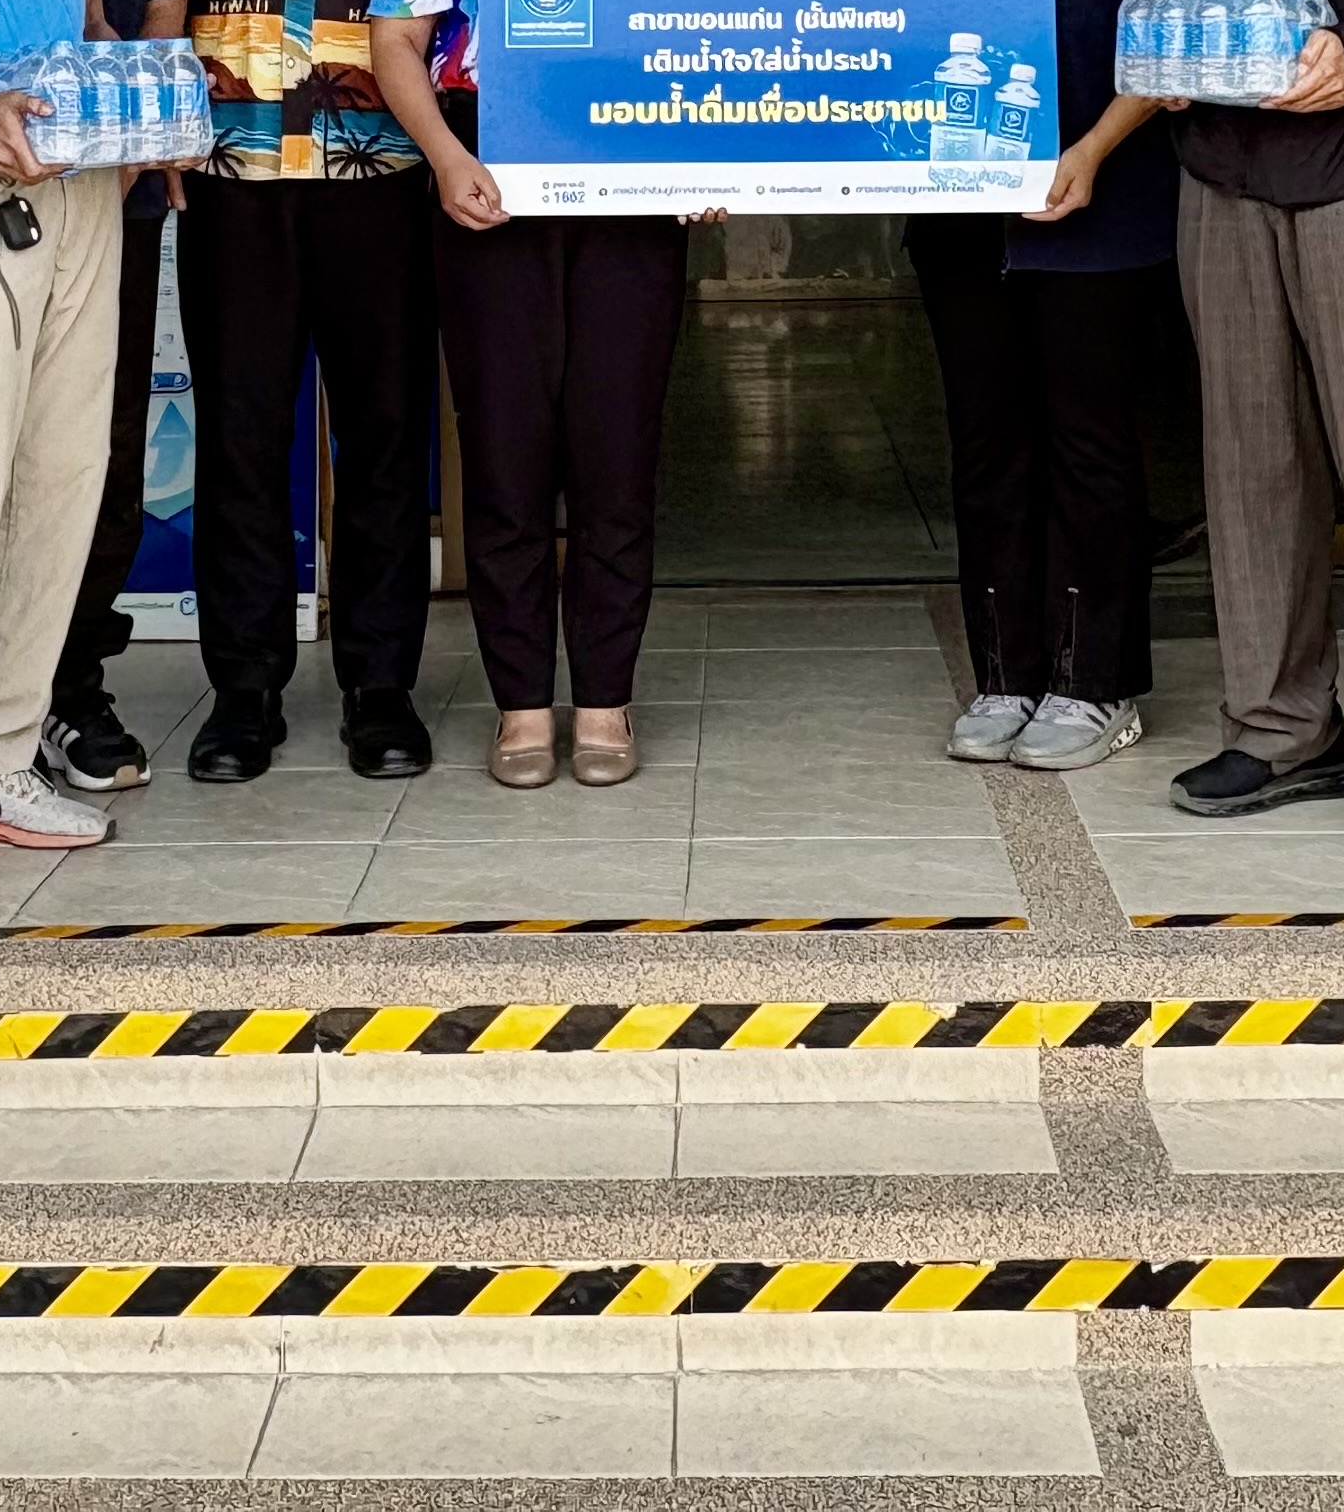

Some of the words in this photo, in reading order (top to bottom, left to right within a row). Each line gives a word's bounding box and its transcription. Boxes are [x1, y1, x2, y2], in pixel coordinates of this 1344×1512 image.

[628, 6, 783, 32] สาขาขอนแก่น
[795, 0, 906, 34] (ชั้นพิเศษ)
[589, 82, 947, 125] มอบน้ำดื่มเพื่อประชาชน
